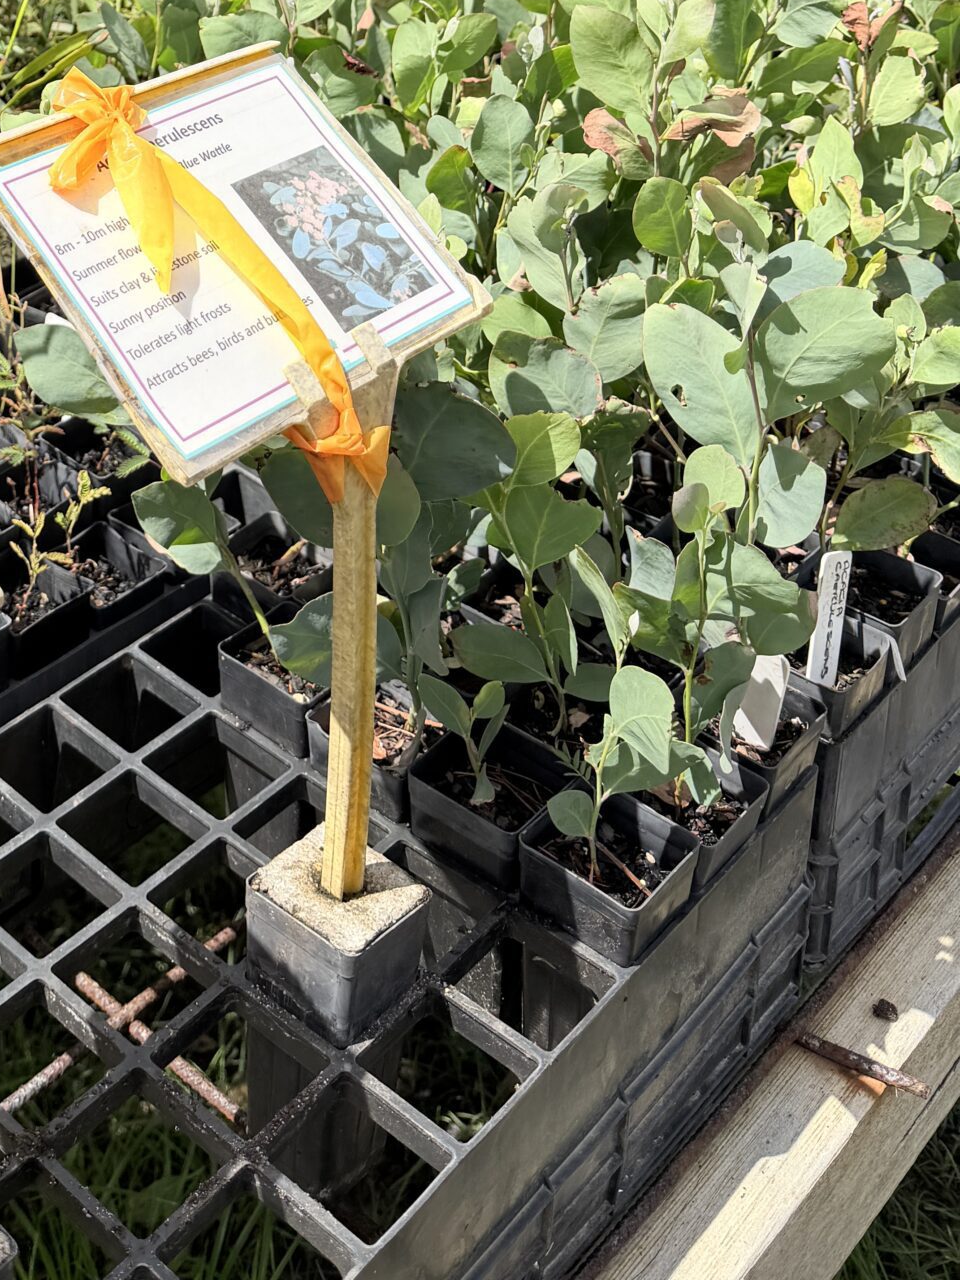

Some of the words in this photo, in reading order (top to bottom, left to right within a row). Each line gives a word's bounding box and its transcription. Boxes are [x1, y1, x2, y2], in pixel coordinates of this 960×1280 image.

[149, 113, 224, 148] erulescens
[198, 141, 233, 163] Wattle
[54, 240, 76, 256] 8m
[81, 227, 107, 245] 10m
[105, 216, 131, 234] high
[72, 254, 119, 282] Summer
[118, 245, 143, 262] flow
[90, 288, 119, 308] Suits
[119, 277, 141, 295] clay
[140, 272, 152, 284] &
[201, 239, 221, 256] soil
[108, 309, 144, 334] Sunny
[144, 289, 187, 319] position
[126, 329, 178, 361] Tolerates
[177, 316, 203, 336] light
[200, 301, 232, 324] frosts
[145, 360, 189, 390] Attracts
[188, 345, 220, 367] bees,
[216, 330, 245, 352] birds
[246, 319, 268, 337] and
[835, 559, 850, 617] ACACIA
